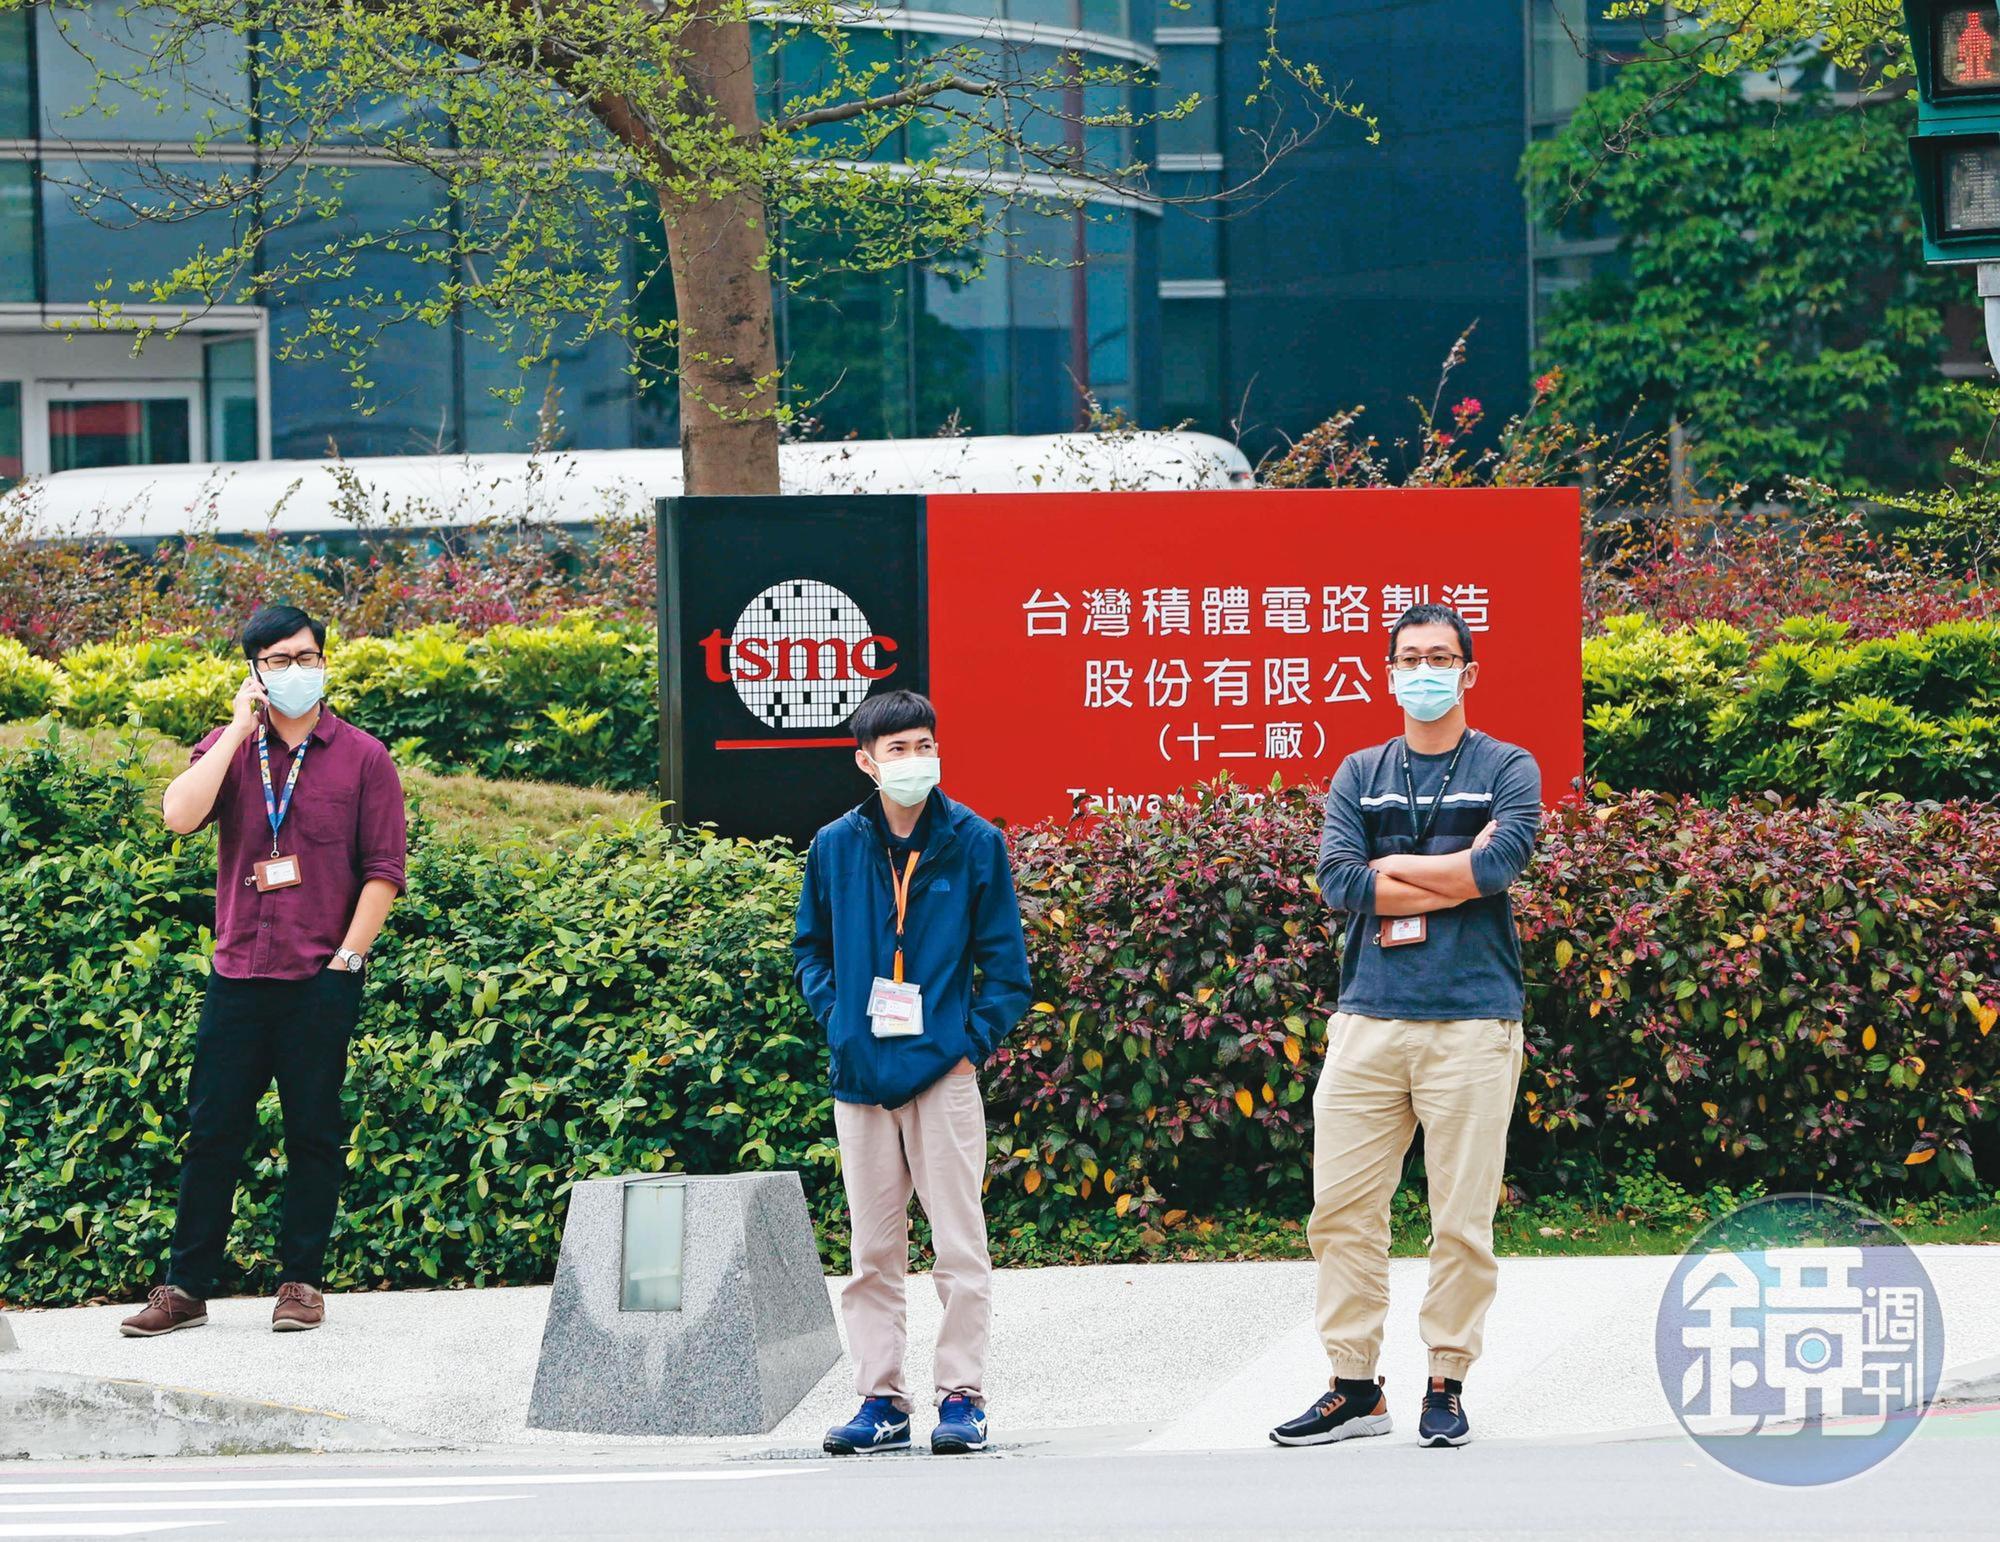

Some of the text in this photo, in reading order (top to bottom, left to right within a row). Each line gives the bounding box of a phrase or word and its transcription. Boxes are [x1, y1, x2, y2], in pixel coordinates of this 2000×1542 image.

[699, 628, 898, 684] tsmc
[1084, 655, 1390, 708] 股份有限公
